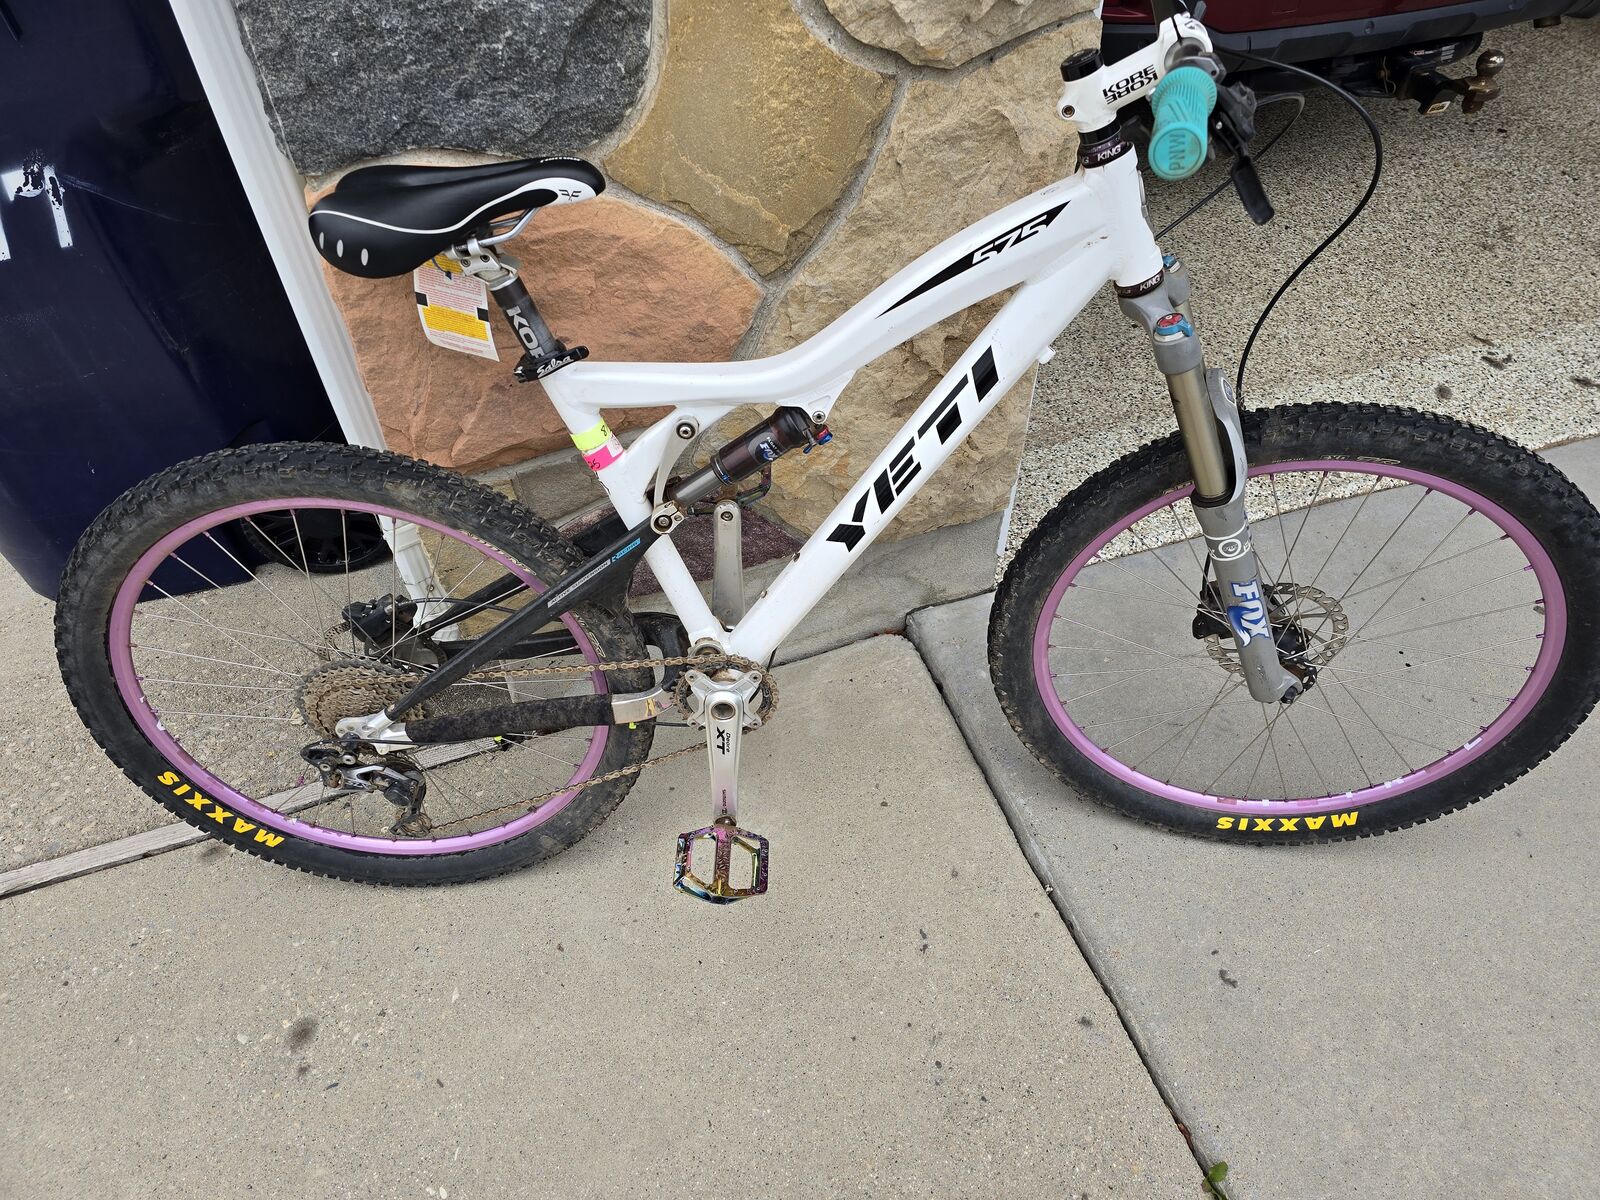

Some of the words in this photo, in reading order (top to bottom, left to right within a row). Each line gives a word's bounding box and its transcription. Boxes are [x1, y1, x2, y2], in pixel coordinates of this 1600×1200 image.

[1102, 64, 1156, 97] KORE
[1097, 145, 1122, 161] KING
[1168, 133, 1187, 171] PNW
[1139, 275, 1162, 292] KING
[536, 354, 574, 378] Salsa
[826, 345, 999, 552] YETI
[1228, 579, 1271, 645] FOX
[716, 727, 726, 754] XT
[157, 770, 285, 848] MAXXIS
[1216, 811, 1359, 832] MAXXIS
